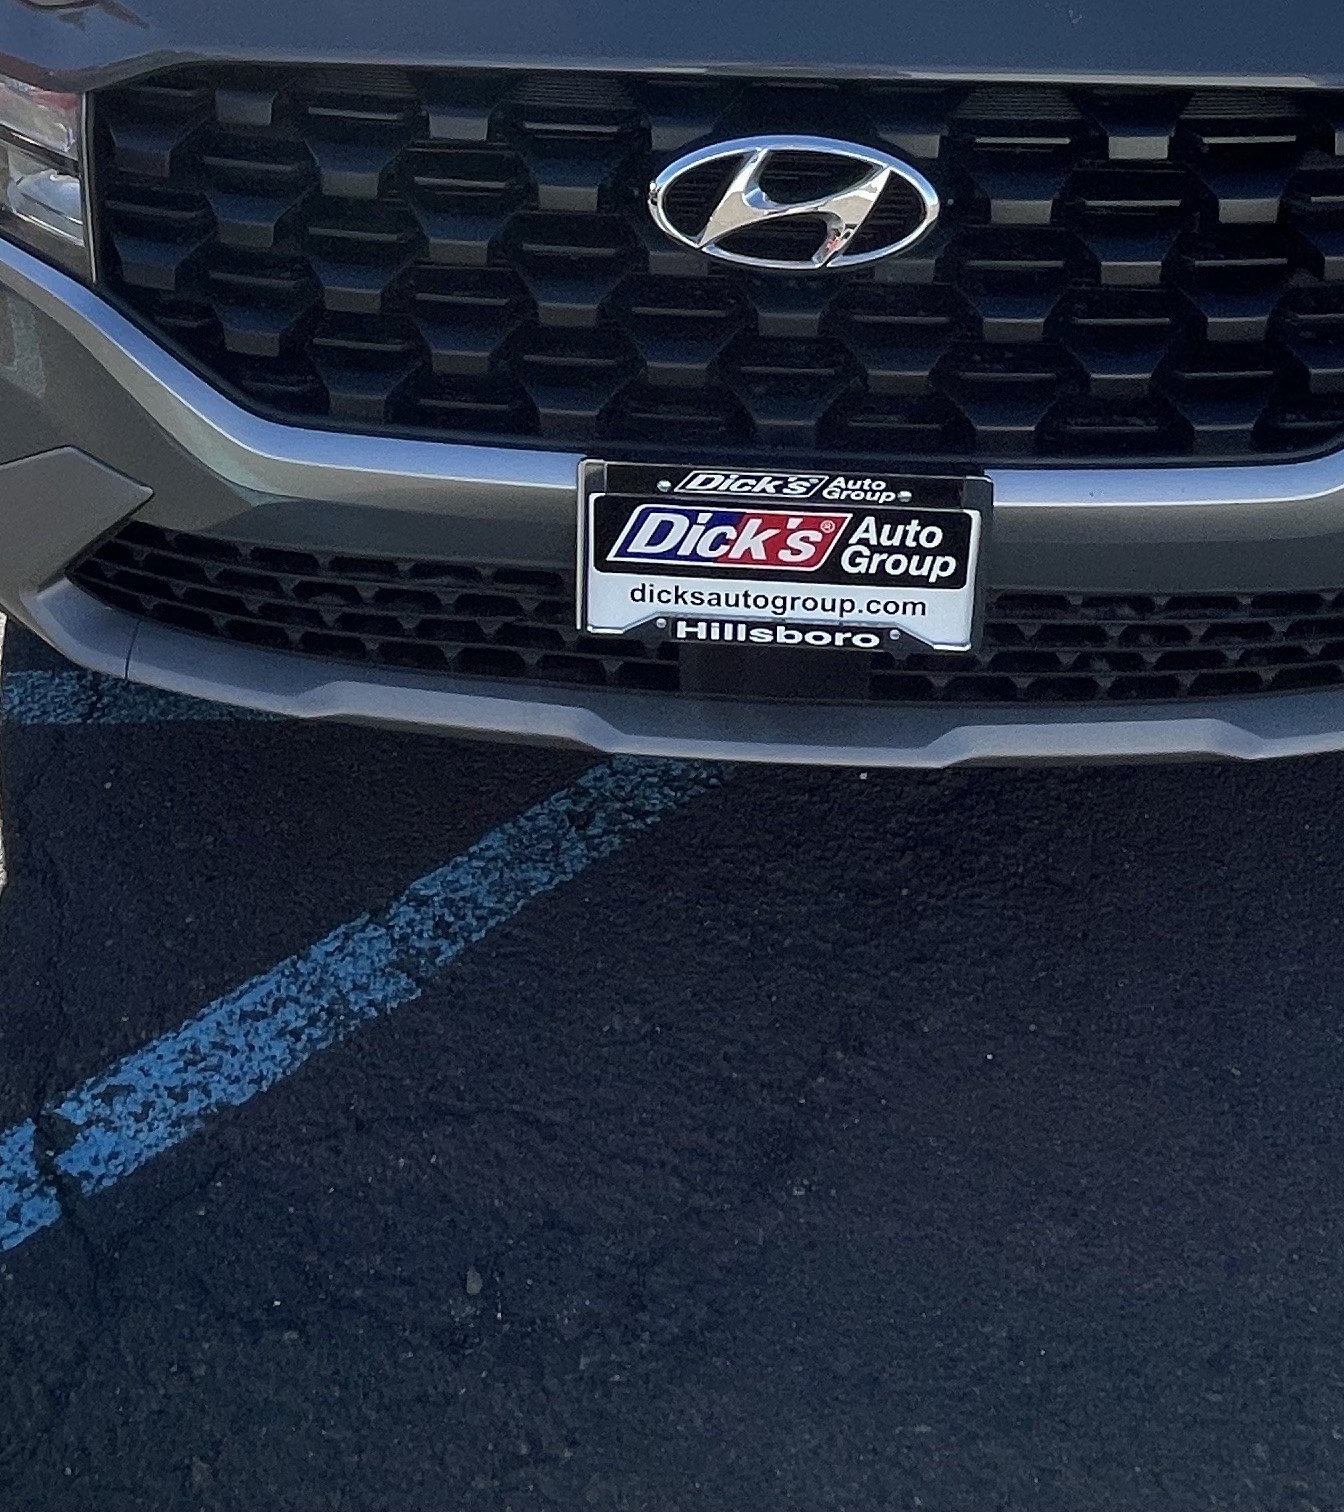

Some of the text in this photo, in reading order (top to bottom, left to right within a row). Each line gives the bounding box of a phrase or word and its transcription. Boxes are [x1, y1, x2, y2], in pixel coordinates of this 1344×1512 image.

[822, 488, 896, 504] Group
[827, 476, 887, 491] Auto
[848, 516, 944, 549] Auto
[841, 544, 957, 583] Group
[629, 583, 927, 618] dicksautogroup.com
[675, 619, 881, 649] Hillsboro
